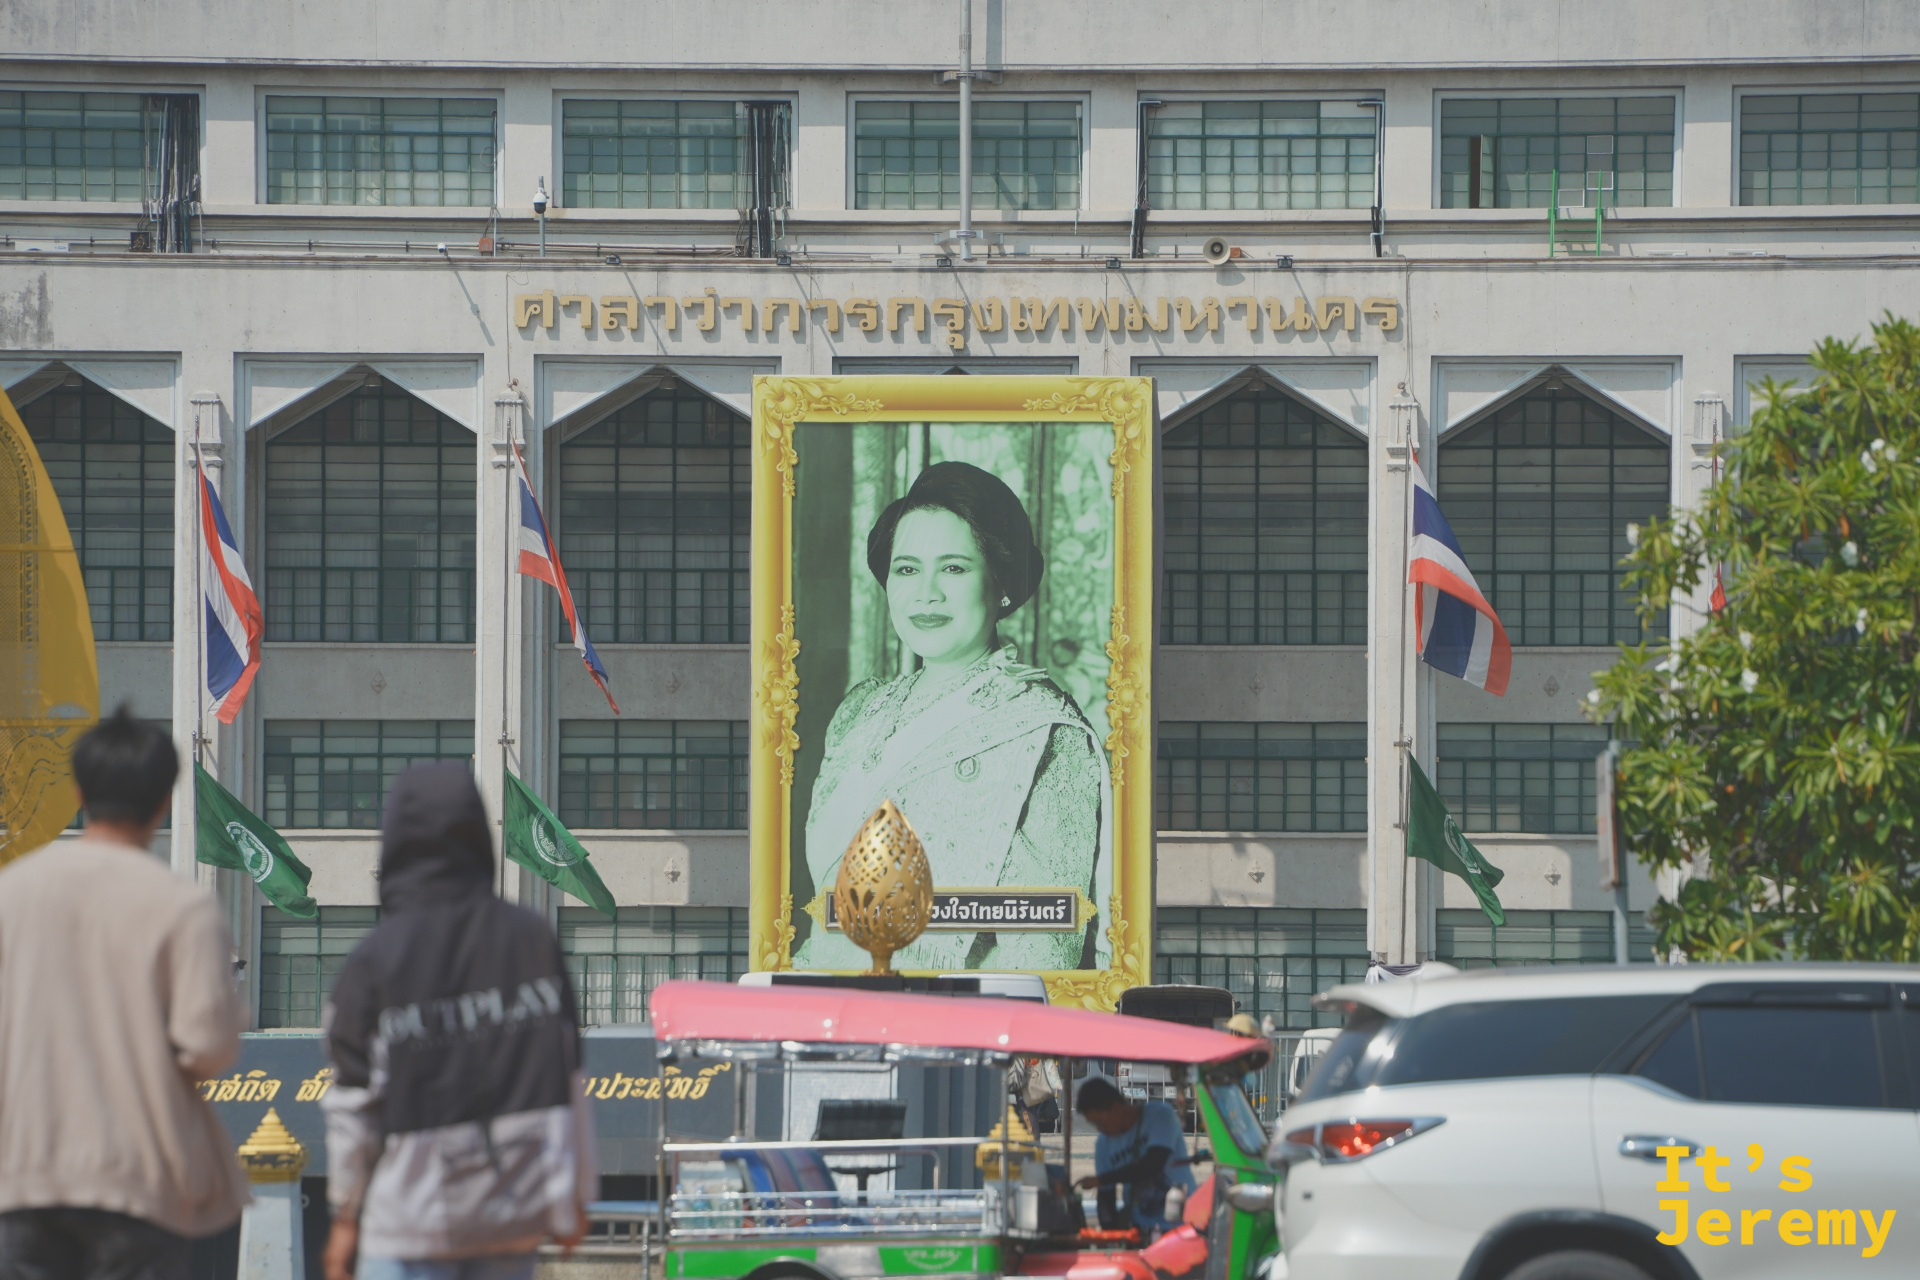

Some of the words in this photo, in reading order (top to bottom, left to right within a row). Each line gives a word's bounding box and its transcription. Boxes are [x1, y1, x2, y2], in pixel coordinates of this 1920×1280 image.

[515, 287, 1398, 350] ศาลาว่าการกรุงเทพมหานคร
